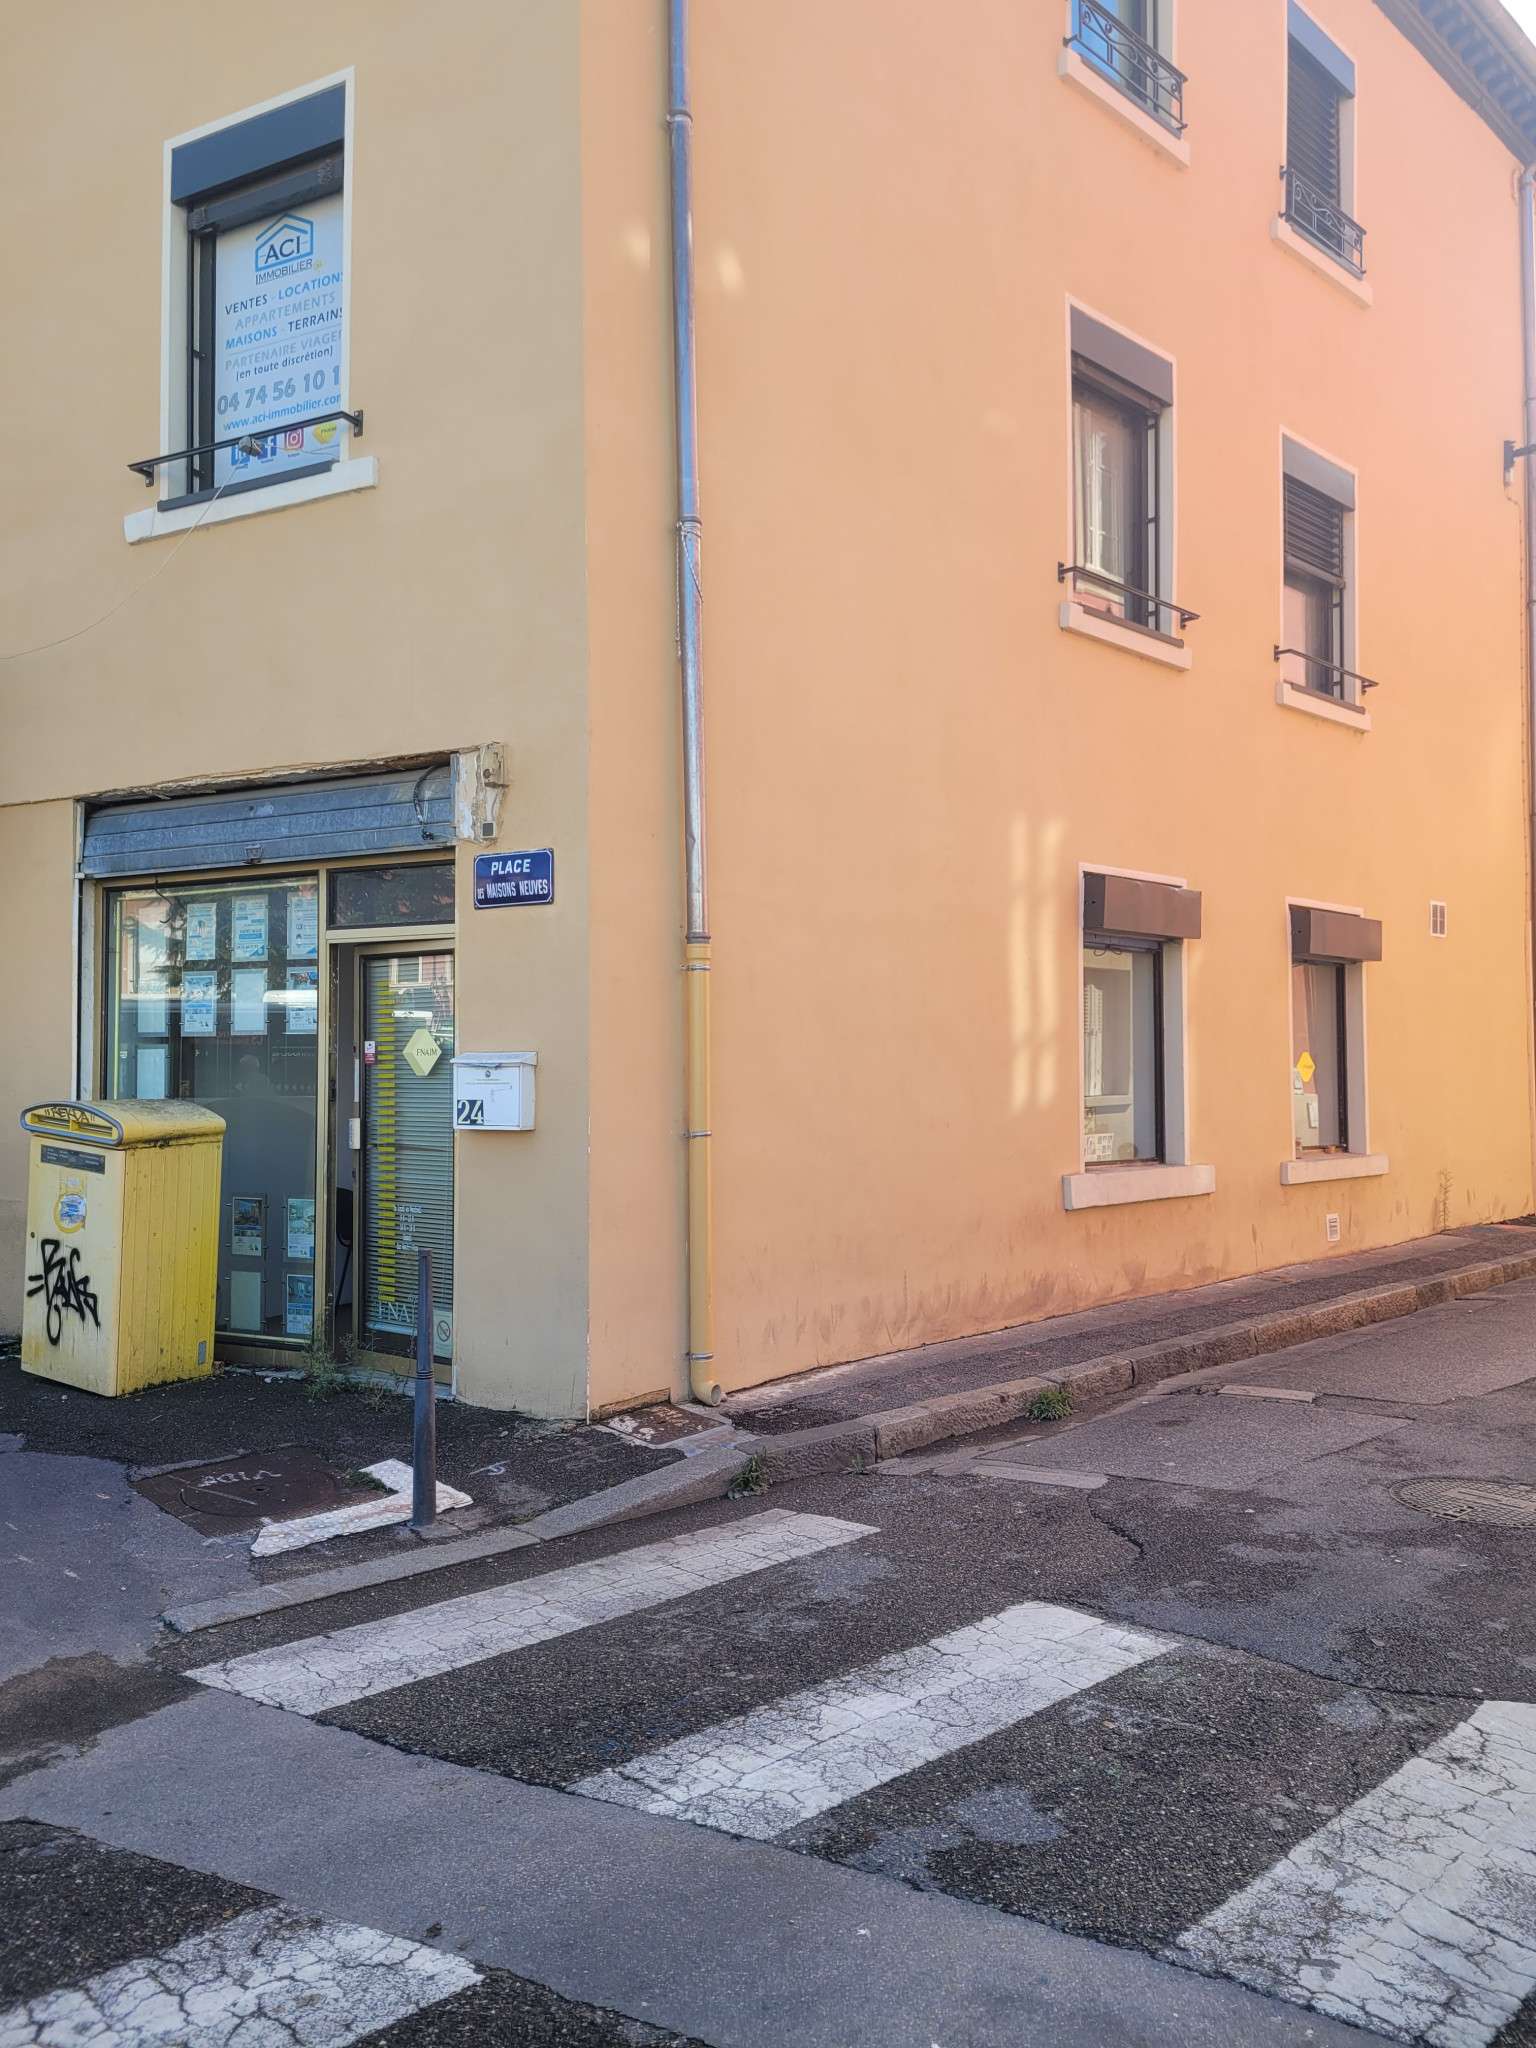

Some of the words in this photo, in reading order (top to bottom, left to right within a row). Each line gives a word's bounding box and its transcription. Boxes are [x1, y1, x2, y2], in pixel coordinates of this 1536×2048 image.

[265, 235, 302, 264] ACI
[255, 258, 313, 286] IMMOBILIER
[225, 294, 268, 316] VENTES
[235, 290, 336, 331] APPARTEMENTS
[225, 326, 278, 350] MAISONS
[225, 343, 297, 371] PARTENAIRE
[254, 361, 279, 376] toute
[217, 391, 240, 416] 04
[244, 383, 268, 409] 74
[272, 377, 297, 401] 56
[303, 369, 326, 394] 10
[490, 859, 532, 876] PLACE
[486, 881, 517, 899] MAISONS
[519, 879, 549, 896] NEUVES
[416, 1047, 439, 1057] FNAIM
[457, 1100, 484, 1125] 24
